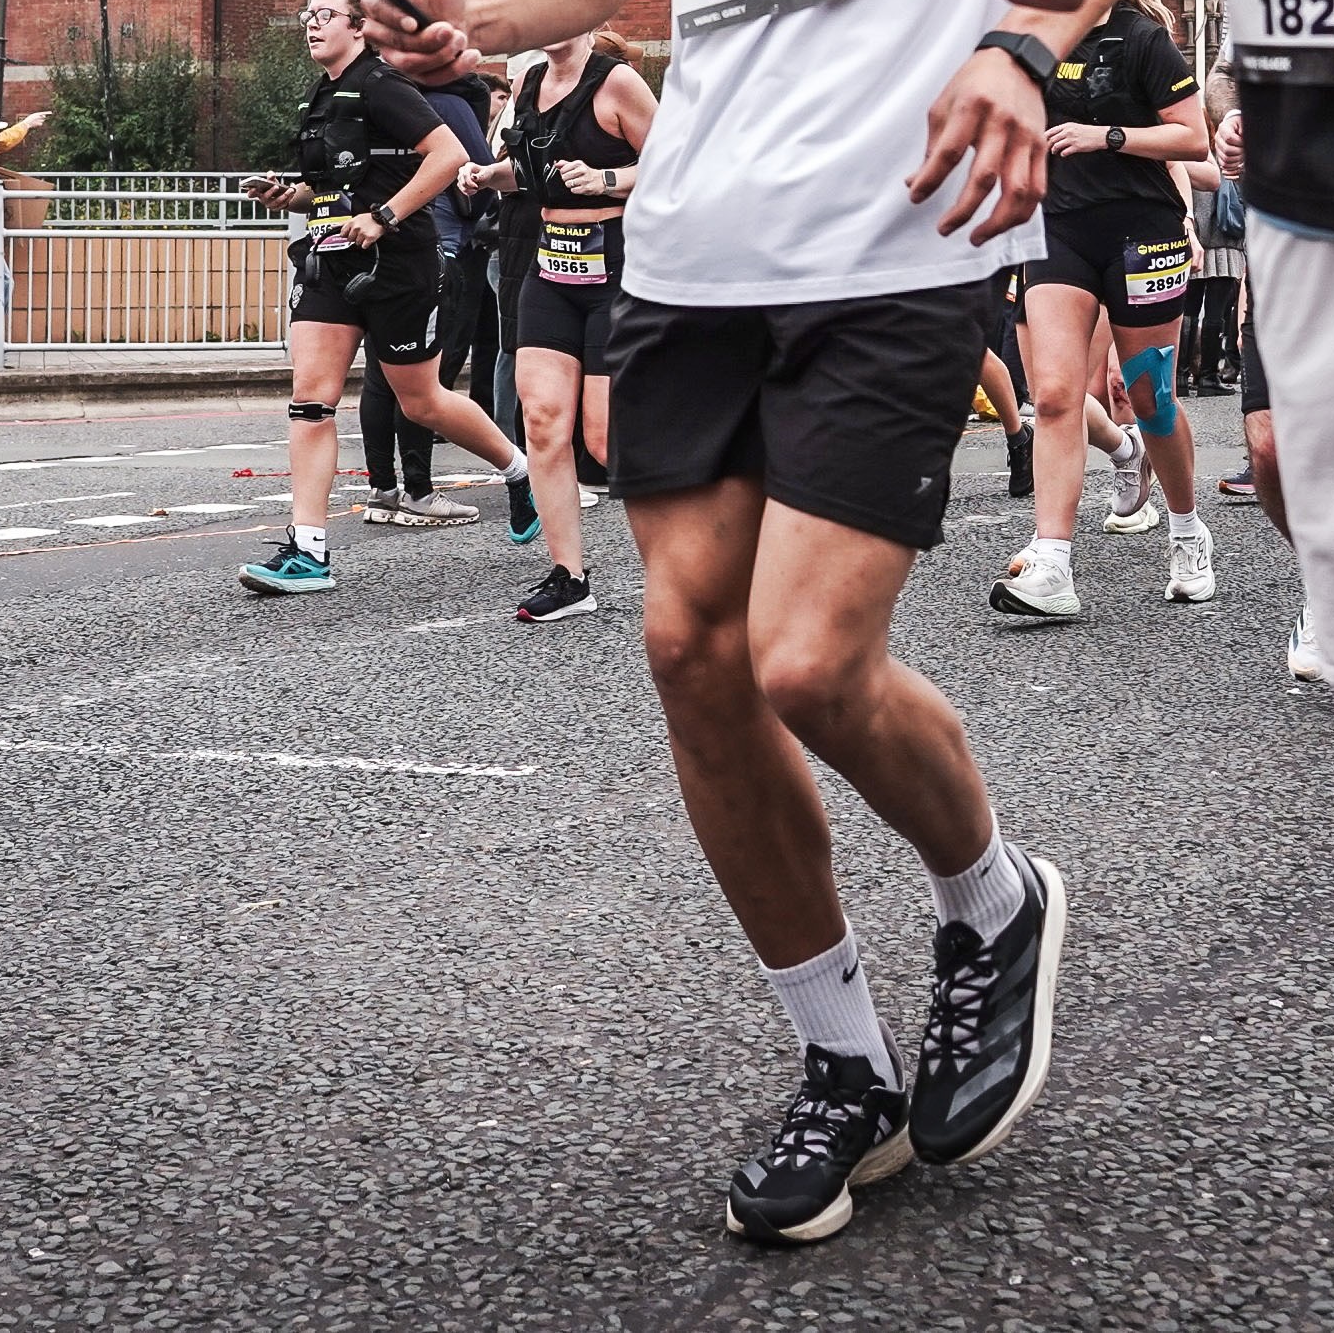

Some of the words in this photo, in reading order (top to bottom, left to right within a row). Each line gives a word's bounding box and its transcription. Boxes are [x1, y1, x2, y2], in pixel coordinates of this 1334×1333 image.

[317, 206, 330, 218] ABI
[551, 225, 566, 236] MCR
[566, 228, 591, 237] HALF
[550, 238, 582, 253] BETH
[1147, 242, 1170, 254] MCR
[547, 258, 589, 274] 19565
[1147, 251, 1186, 270] JODIE
[1145, 270, 1186, 294] 28941
[389, 341, 418, 352] VX3
